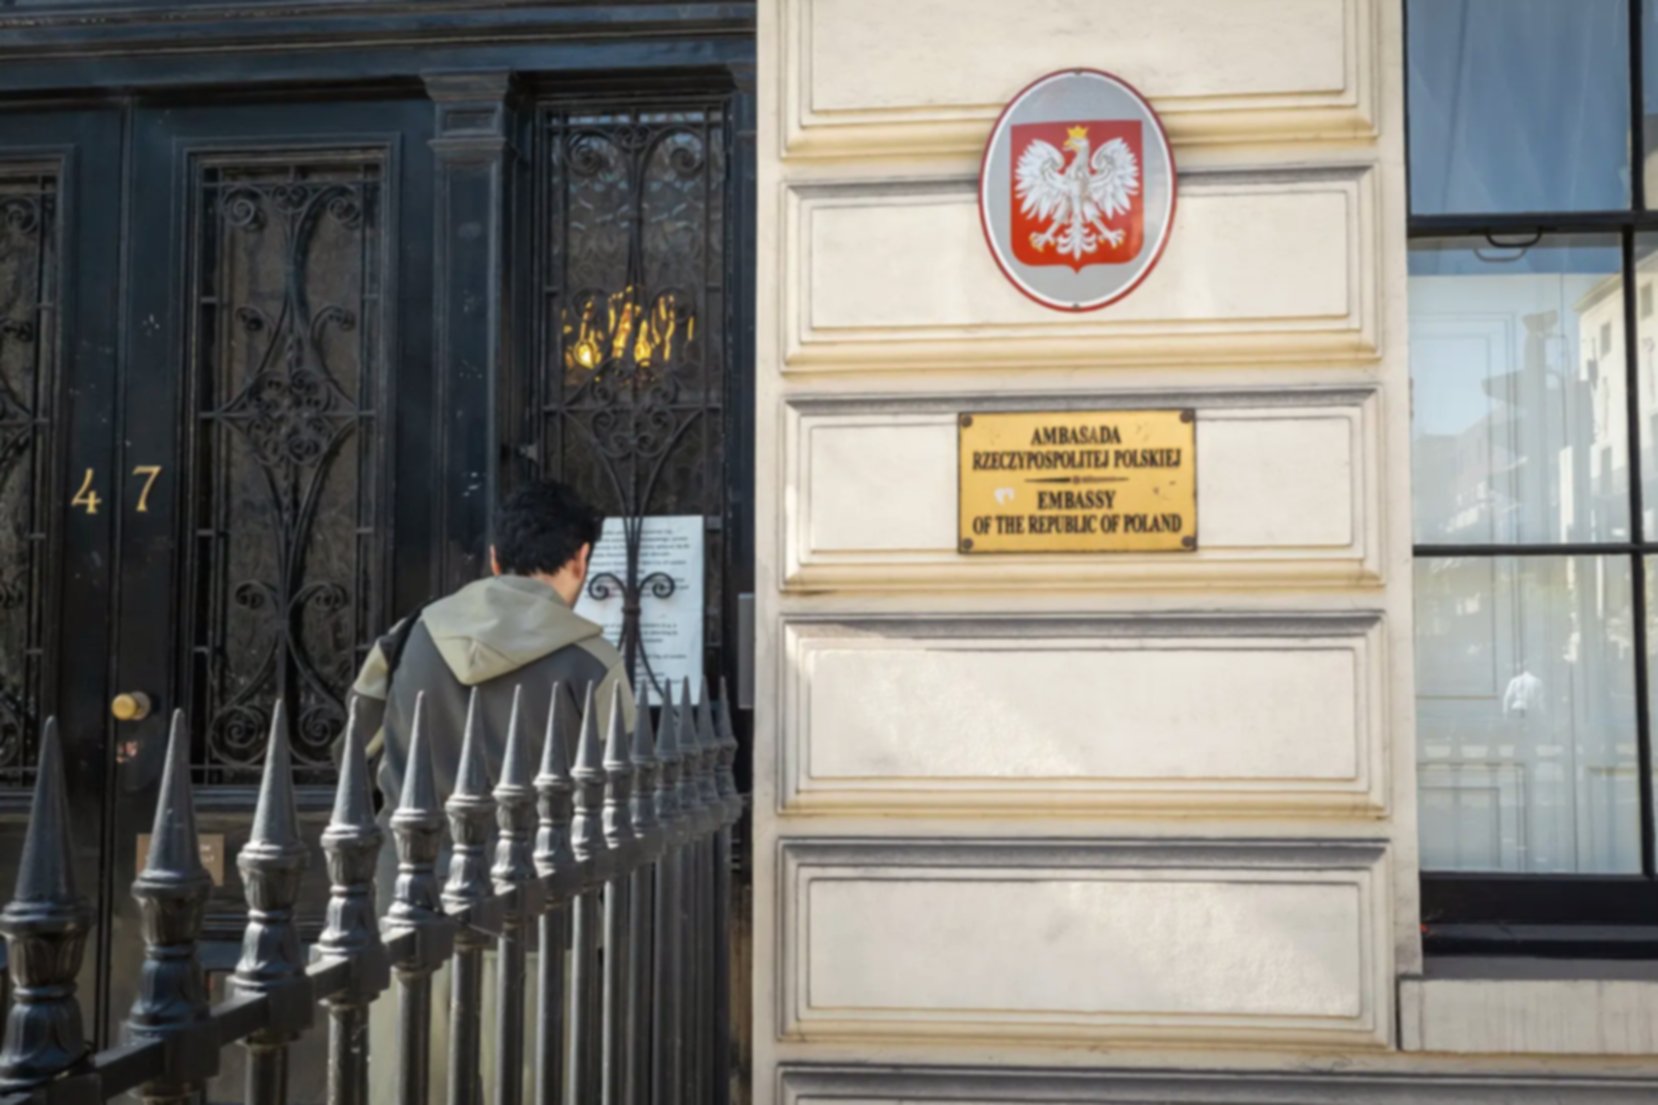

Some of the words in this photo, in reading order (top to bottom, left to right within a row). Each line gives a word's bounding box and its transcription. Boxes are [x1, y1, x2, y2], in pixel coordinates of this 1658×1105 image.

[1030, 426, 1122, 445] AMBASADA
[972, 450, 1110, 470] RZECZYPOSPOLITEJ
[1114, 449, 1182, 468] POLSKIEJ
[1037, 490, 1116, 510] EMBASSY
[972, 516, 992, 535] OF
[995, 516, 1025, 534] THE
[1028, 515, 1097, 534] REPUBLIC
[1101, 514, 1122, 533] OF
[1124, 513, 1182, 533] POLAND
